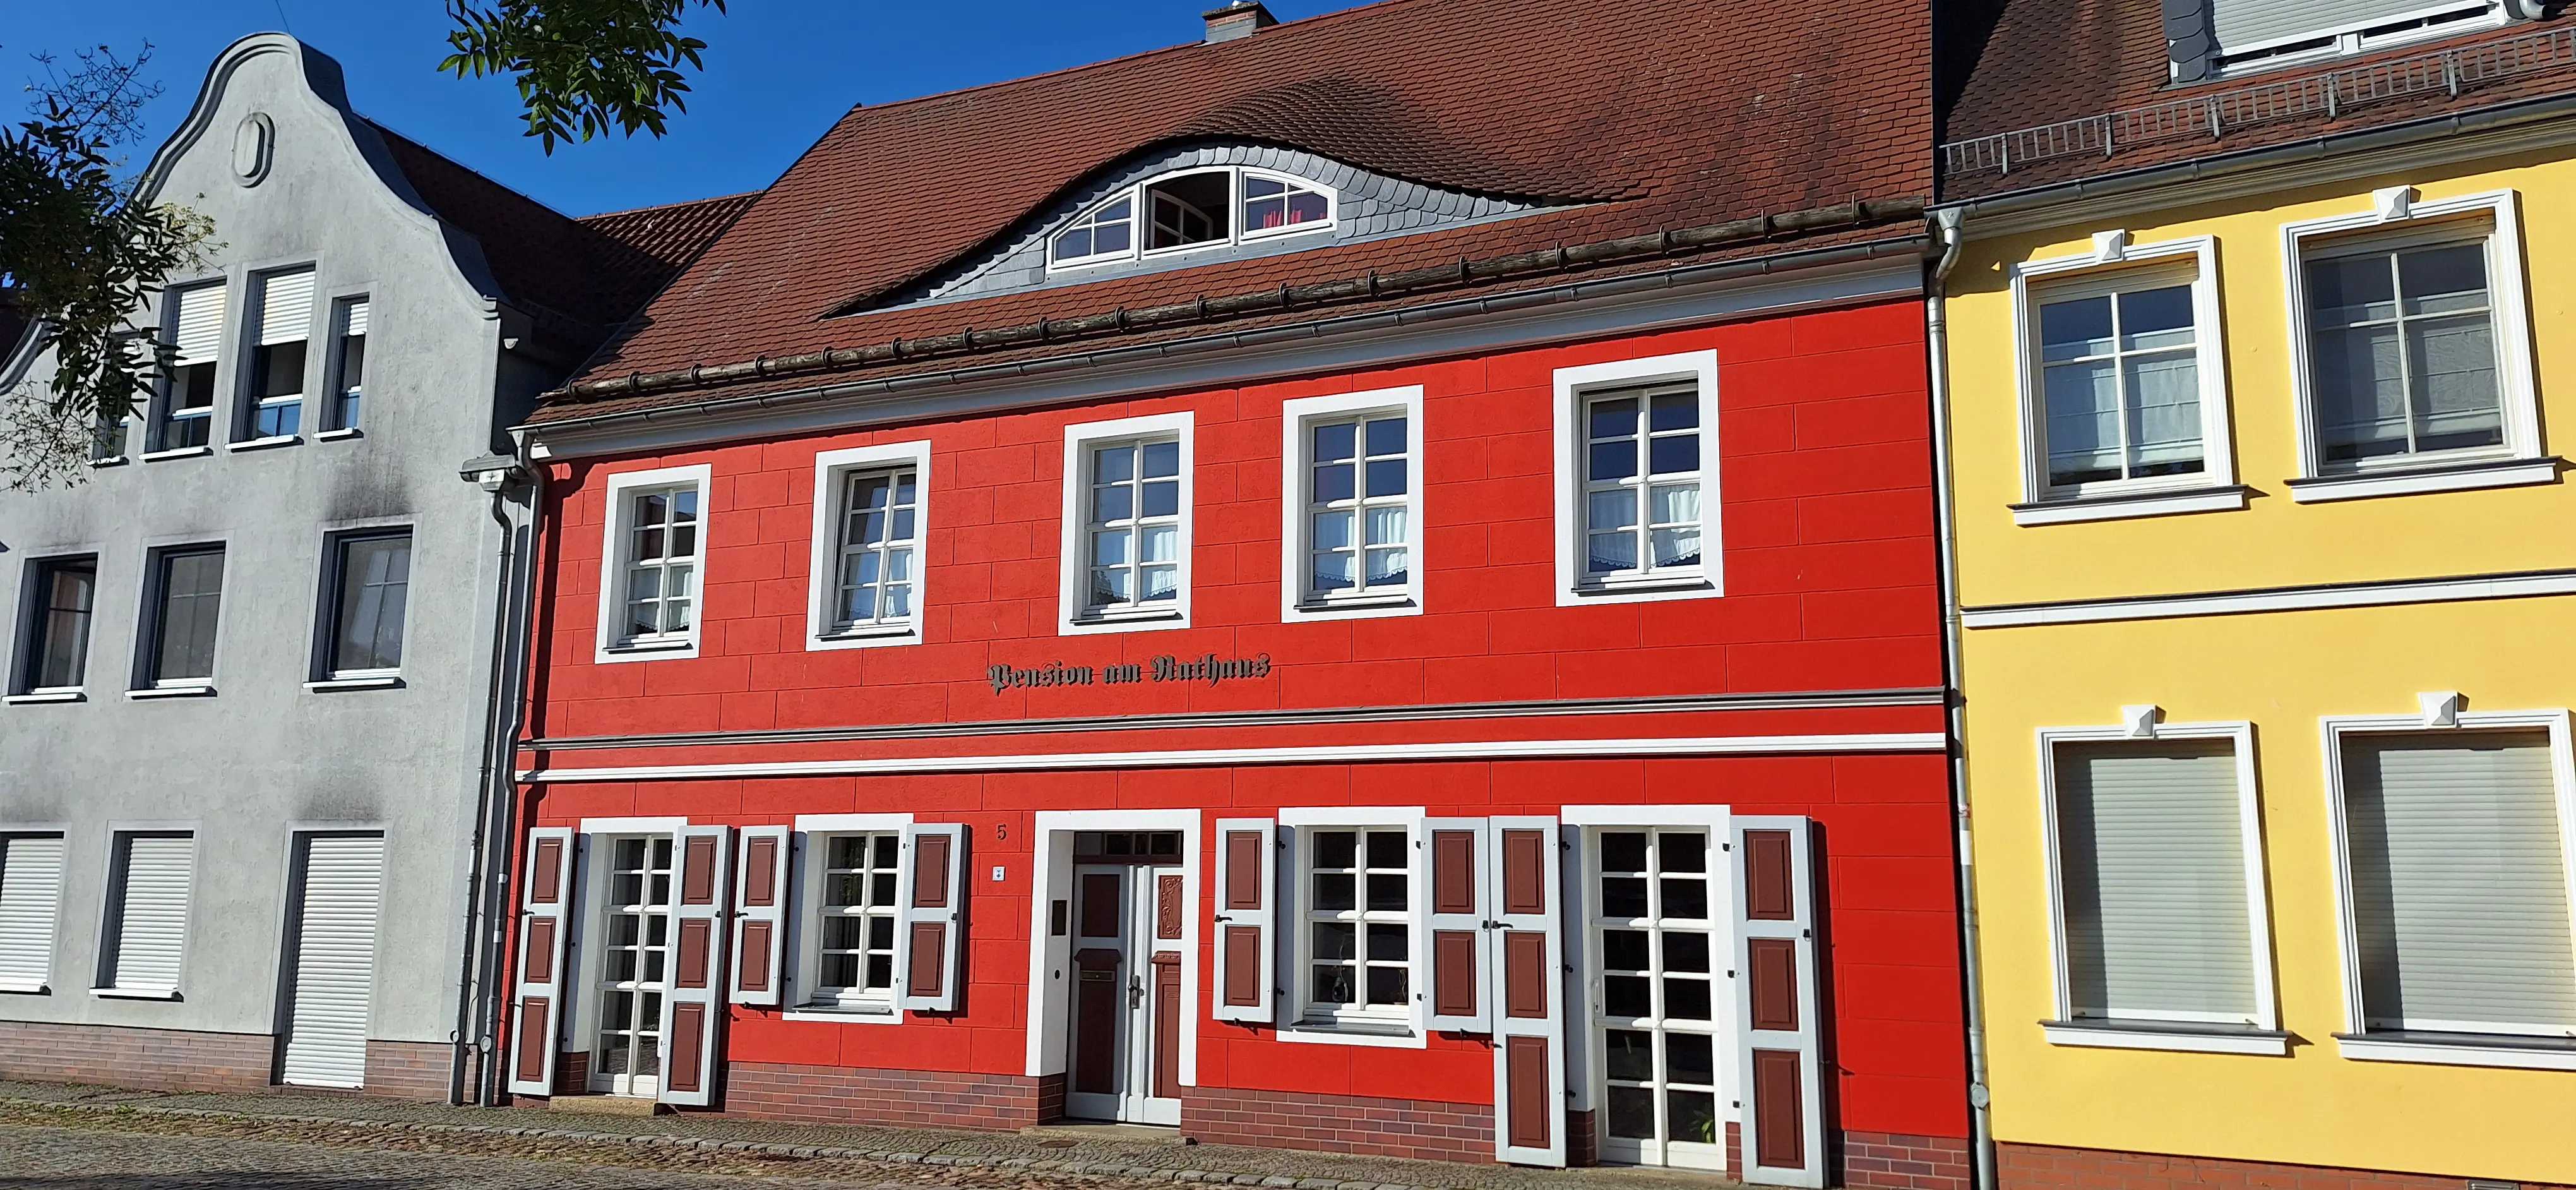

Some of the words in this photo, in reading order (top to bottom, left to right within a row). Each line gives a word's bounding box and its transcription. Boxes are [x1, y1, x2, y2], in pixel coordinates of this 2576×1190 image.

[987, 660, 1094, 697] Pension
[1103, 663, 1142, 685] am
[1150, 652, 1271, 688] Rathaus
[998, 824, 1006, 840] 5
